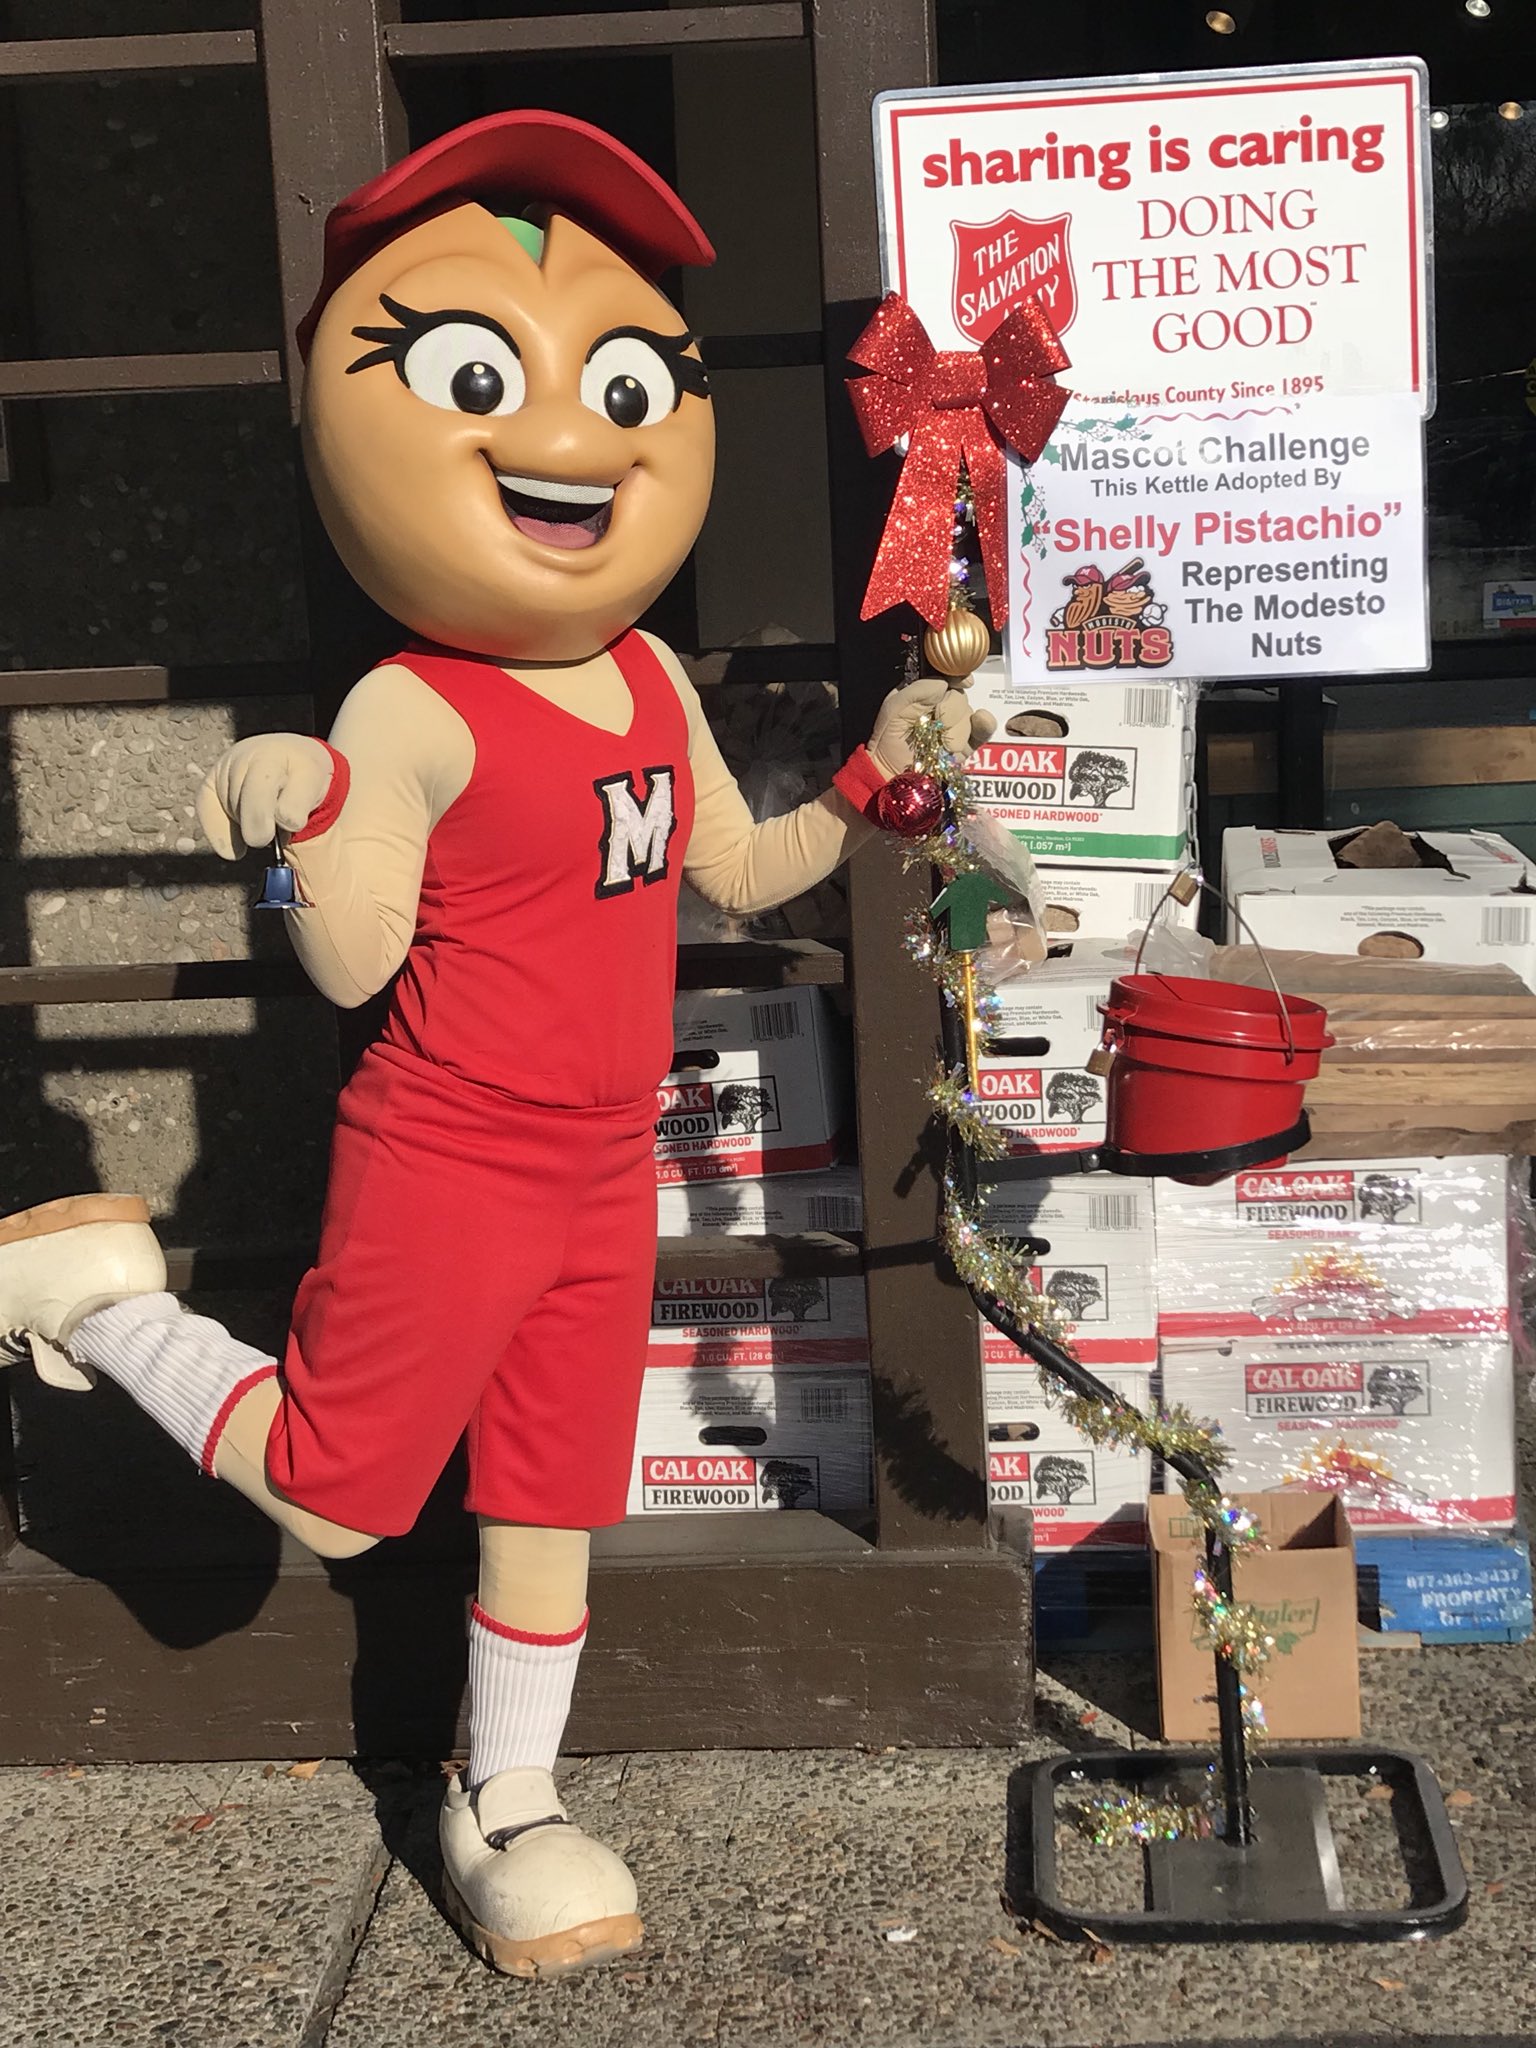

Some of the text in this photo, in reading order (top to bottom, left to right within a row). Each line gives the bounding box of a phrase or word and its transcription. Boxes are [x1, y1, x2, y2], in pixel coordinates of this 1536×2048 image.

[923, 115, 1385, 190] sharing is caring
[1138, 189, 1319, 240] DOING
[973, 229, 1020, 277] THE
[960, 233, 1061, 327] SALVATION
[1092, 255, 1201, 301] THE
[1215, 243, 1367, 293] MOST
[1152, 303, 1313, 354] GOOD
[1165, 386, 1226, 406] County
[1230, 381, 1275, 399] Since
[1282, 376, 1325, 396] 1895
[1060, 431, 1371, 472] Mascot Challenge
[1091, 468, 1342, 498] This Kettle Adopted By
[1181, 555, 1389, 591] Representing
[1185, 588, 1386, 624] The Modesto
[1046, 627, 1173, 670] NUTS
[1250, 632, 1323, 659] Nuts
[963, 748, 1059, 774] AL OAK
[969, 779, 1057, 801] REWOOD
[986, 808, 1031, 820] ASONED
[593, 765, 677, 899] M
[981, 1073, 1034, 1096] OAK
[653, 1116, 710, 1136] WOOD
[655, 1142, 690, 1155] SONED
[660, 1302, 759, 1321] FIREWOOD
[682, 1326, 738, 1338] SEASONED
[1252, 1366, 1356, 1390] CAL OAK
[649, 1460, 749, 1481] CAL OAK
[990, 1456, 1022, 1477] AK
[651, 1489, 750, 1505] FIREWOOD
